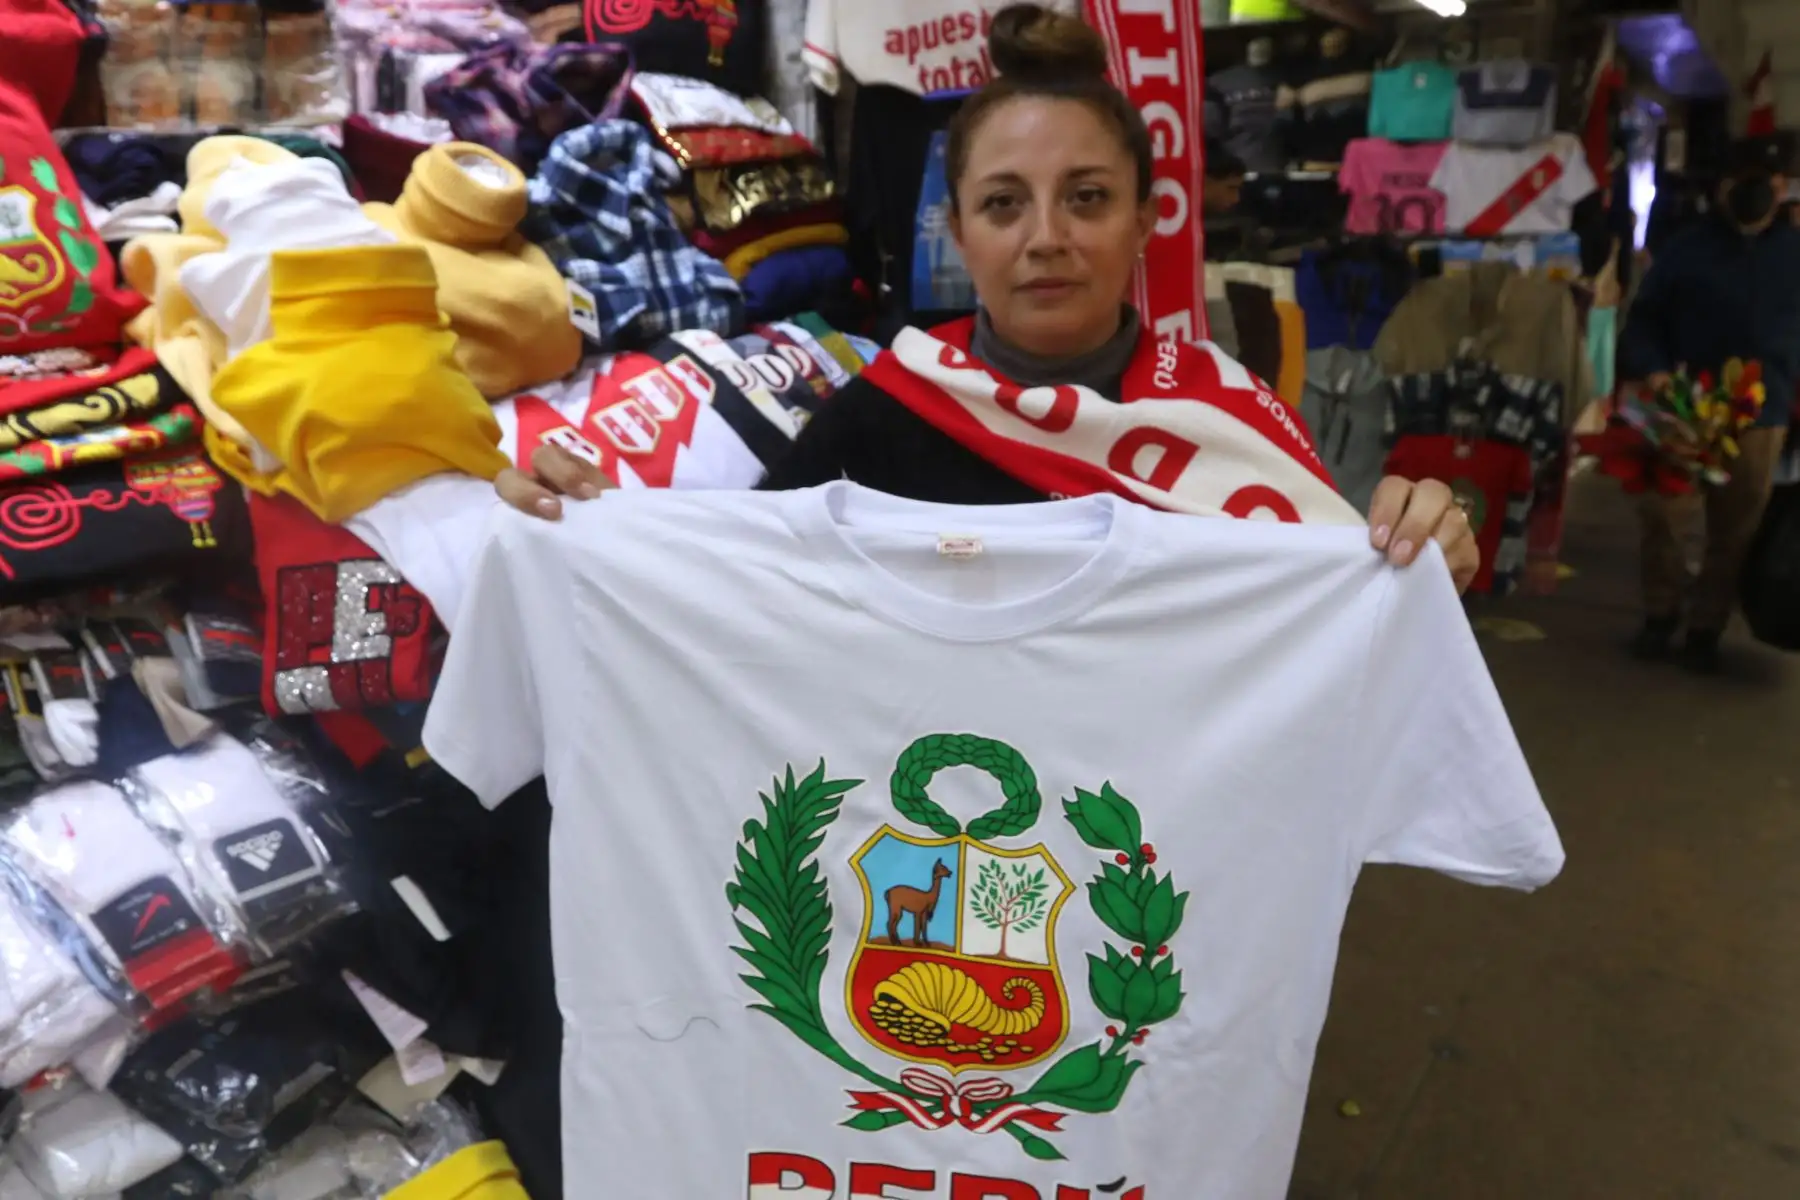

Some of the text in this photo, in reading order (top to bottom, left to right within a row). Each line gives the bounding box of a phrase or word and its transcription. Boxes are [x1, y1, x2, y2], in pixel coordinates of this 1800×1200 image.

[885, 8, 991, 65] apuest
[919, 44, 990, 94] total
[1153, 338, 1179, 390] ERÚ
